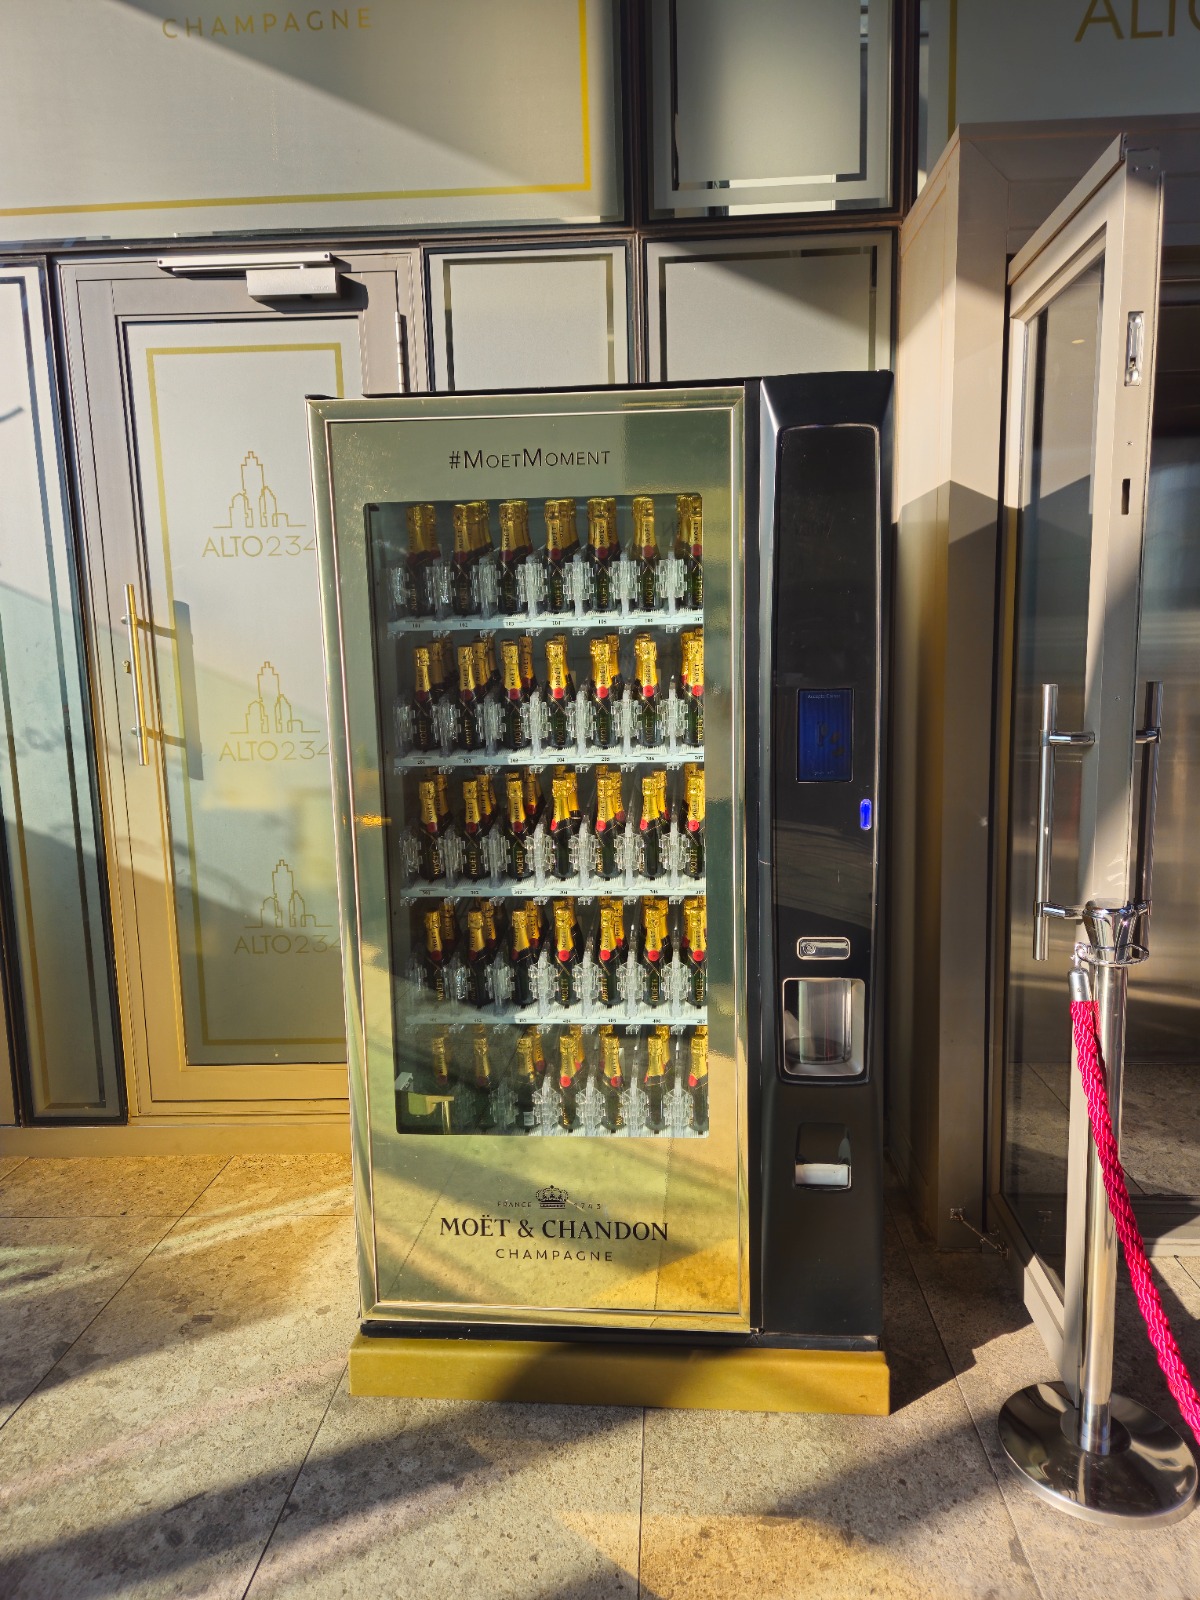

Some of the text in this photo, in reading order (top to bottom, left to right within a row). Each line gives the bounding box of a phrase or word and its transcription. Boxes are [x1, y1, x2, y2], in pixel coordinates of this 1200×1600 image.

[161, 7, 373, 39] CHAMPAGNE
[201, 535, 317, 558] ALTO234
[218, 740, 329, 762] ALTO234
[439, 1214, 669, 1242] MOËT & CHANDON
[495, 1248, 613, 1262] CHAMPAGNE
